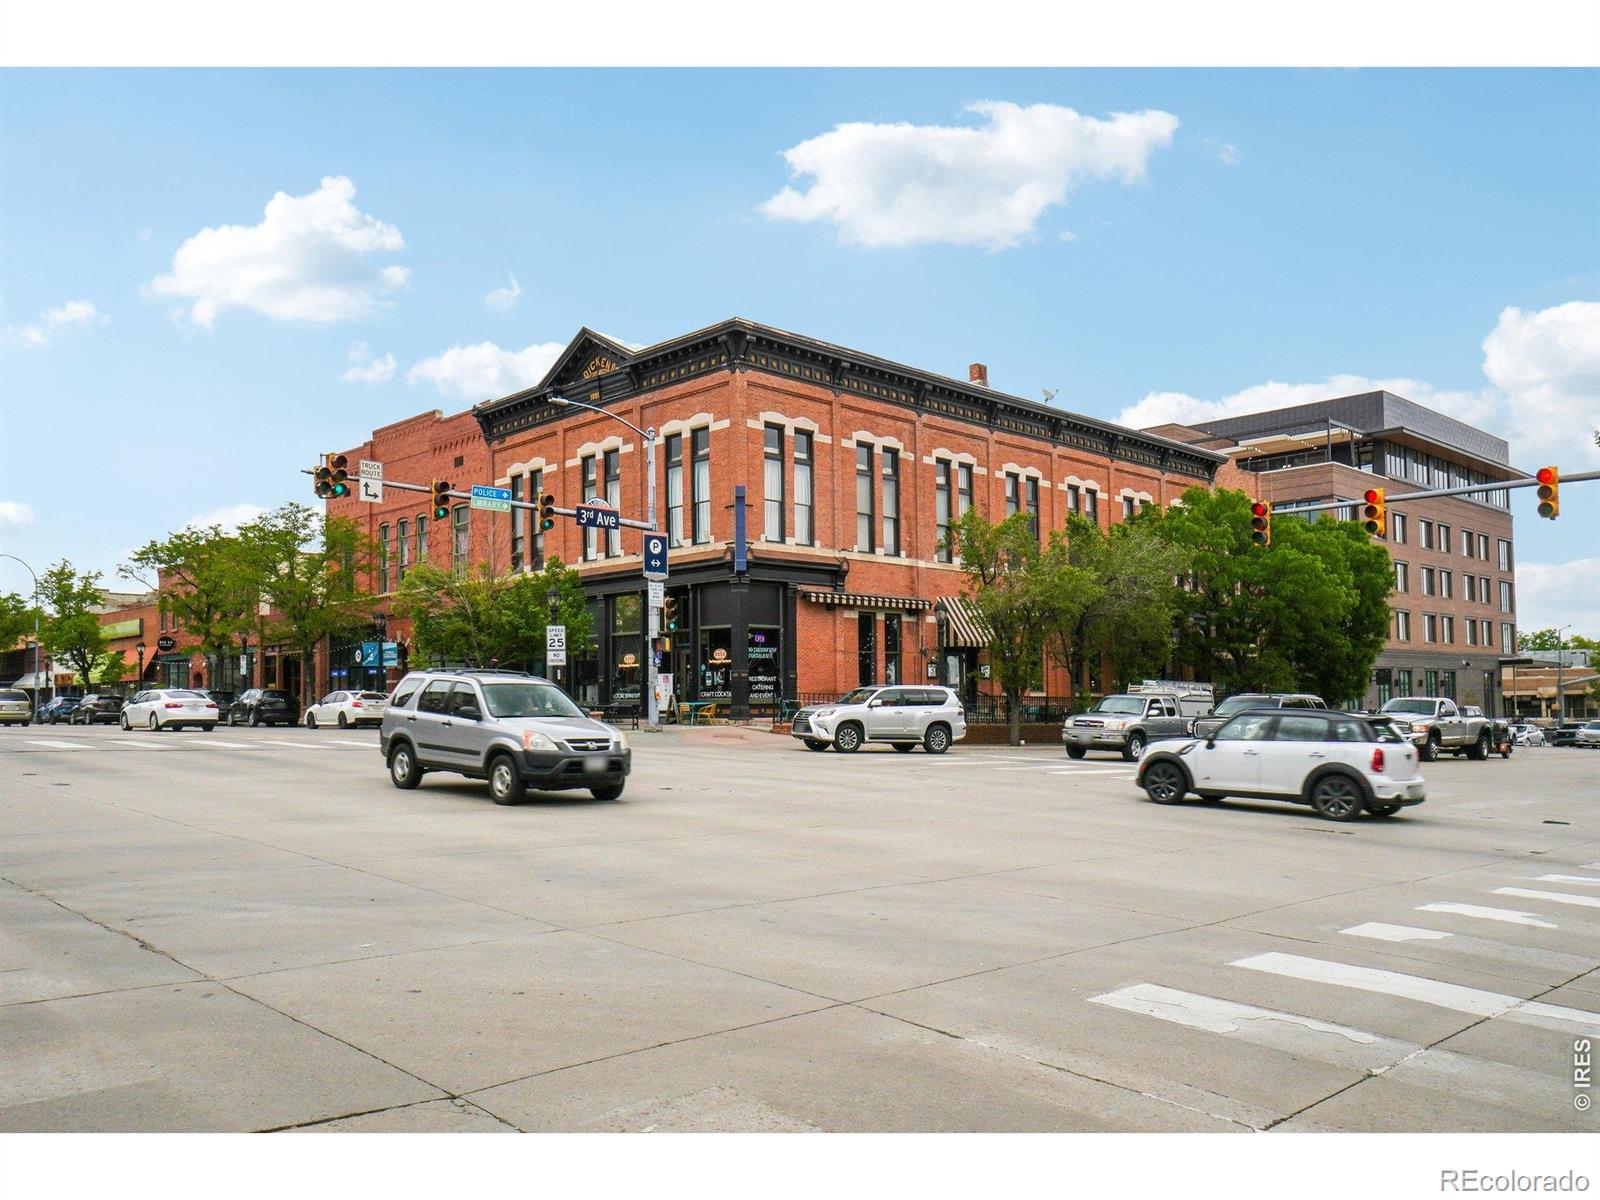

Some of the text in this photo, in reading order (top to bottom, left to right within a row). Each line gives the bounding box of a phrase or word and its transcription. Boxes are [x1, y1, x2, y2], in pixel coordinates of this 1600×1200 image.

[583, 356, 617, 379] DICKENS
[361, 462, 381, 470] TRUCK
[361, 469, 381, 477] ROUTE
[473, 488, 497, 498] POLICE
[473, 499, 502, 509] LIBRARY
[580, 510, 616, 527] 3rd Ave
[653, 542, 659, 551] P
[549, 638, 564, 648] 25
